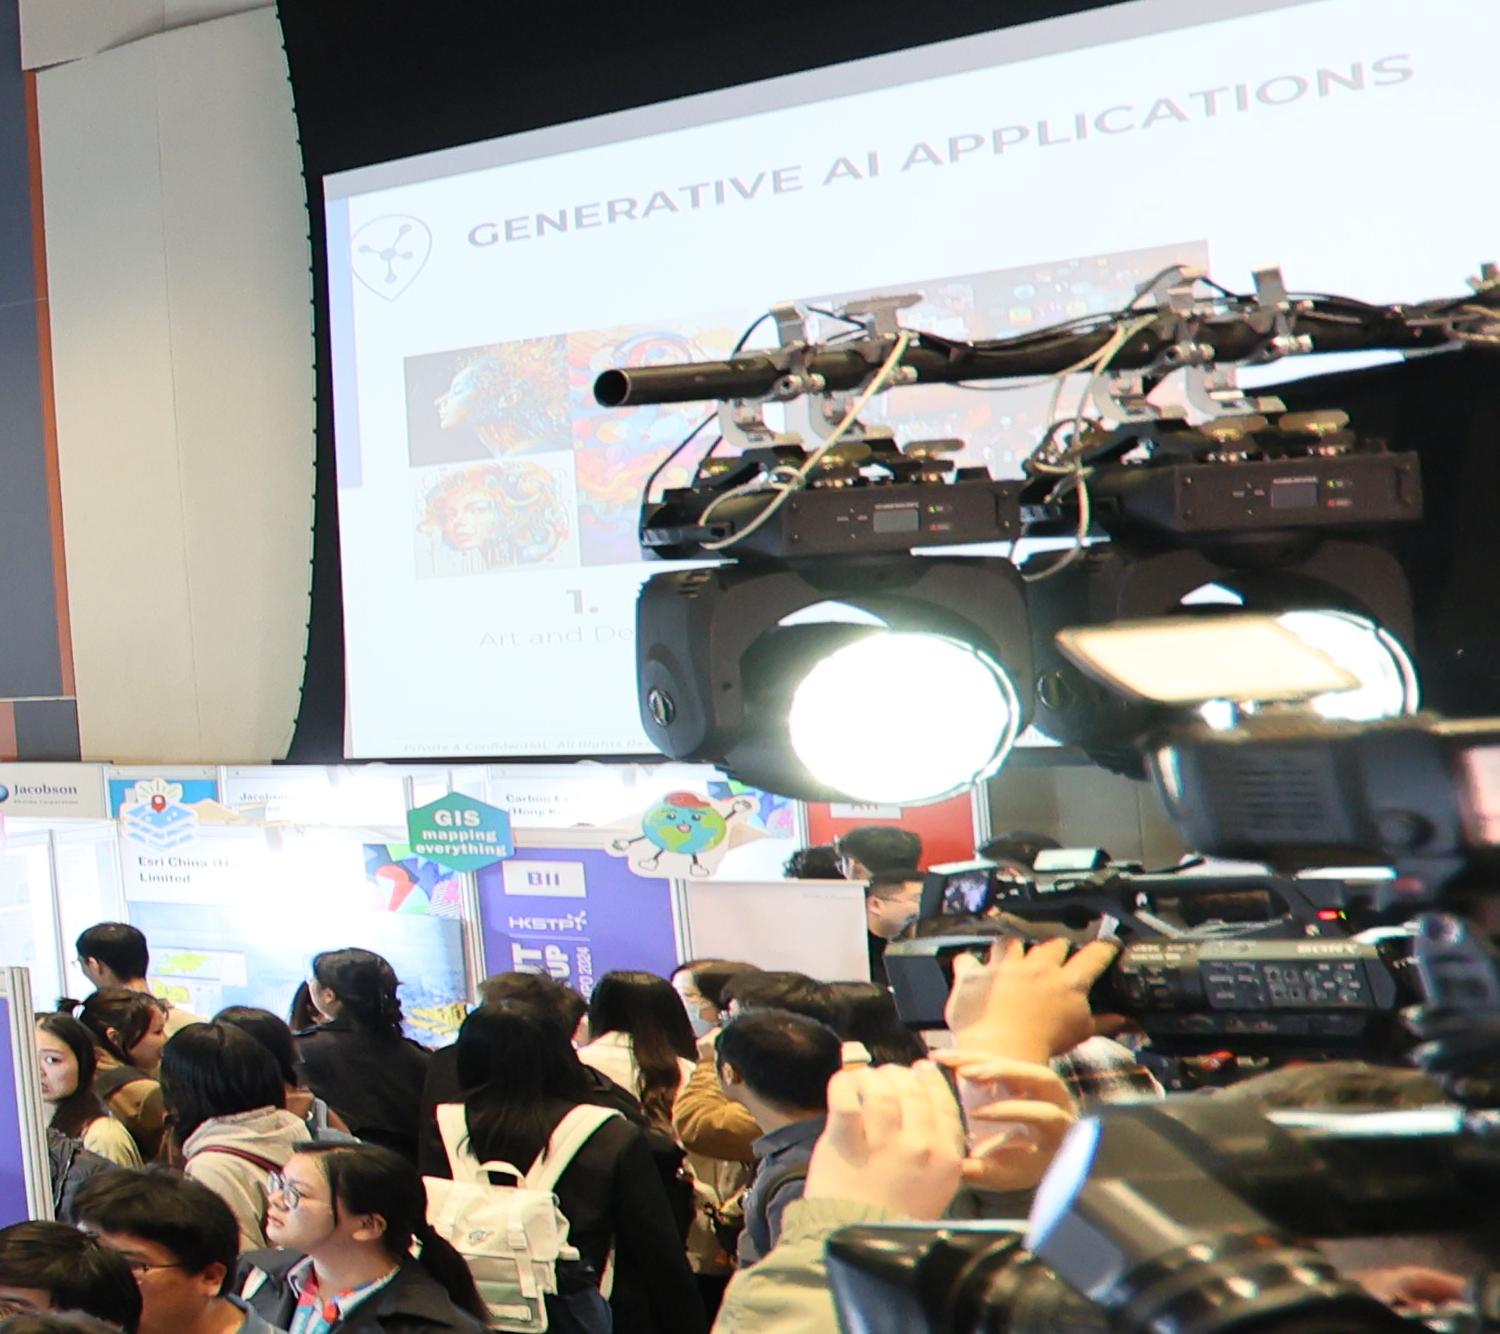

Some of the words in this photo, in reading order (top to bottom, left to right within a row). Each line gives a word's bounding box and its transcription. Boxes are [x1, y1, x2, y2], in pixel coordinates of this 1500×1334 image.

[467, 166, 804, 250] GENERATIVE
[821, 152, 881, 182] AI
[901, 54, 1416, 174] APPLICATIONS
[566, 589, 599, 615] 1.
[479, 630, 521, 649] Art
[530, 626, 582, 646] and
[14, 782, 78, 797] Jacobson
[506, 794, 551, 803] Carbon
[434, 808, 481, 827] GIS
[422, 828, 497, 844] mapping
[415, 841, 507, 857] everything
[138, 856, 164, 867] Esri
[167, 857, 207, 868] China
[139, 872, 191, 884] Limited
[509, 916, 570, 931] HKSTP
[1296, 943, 1356, 956] SONY
